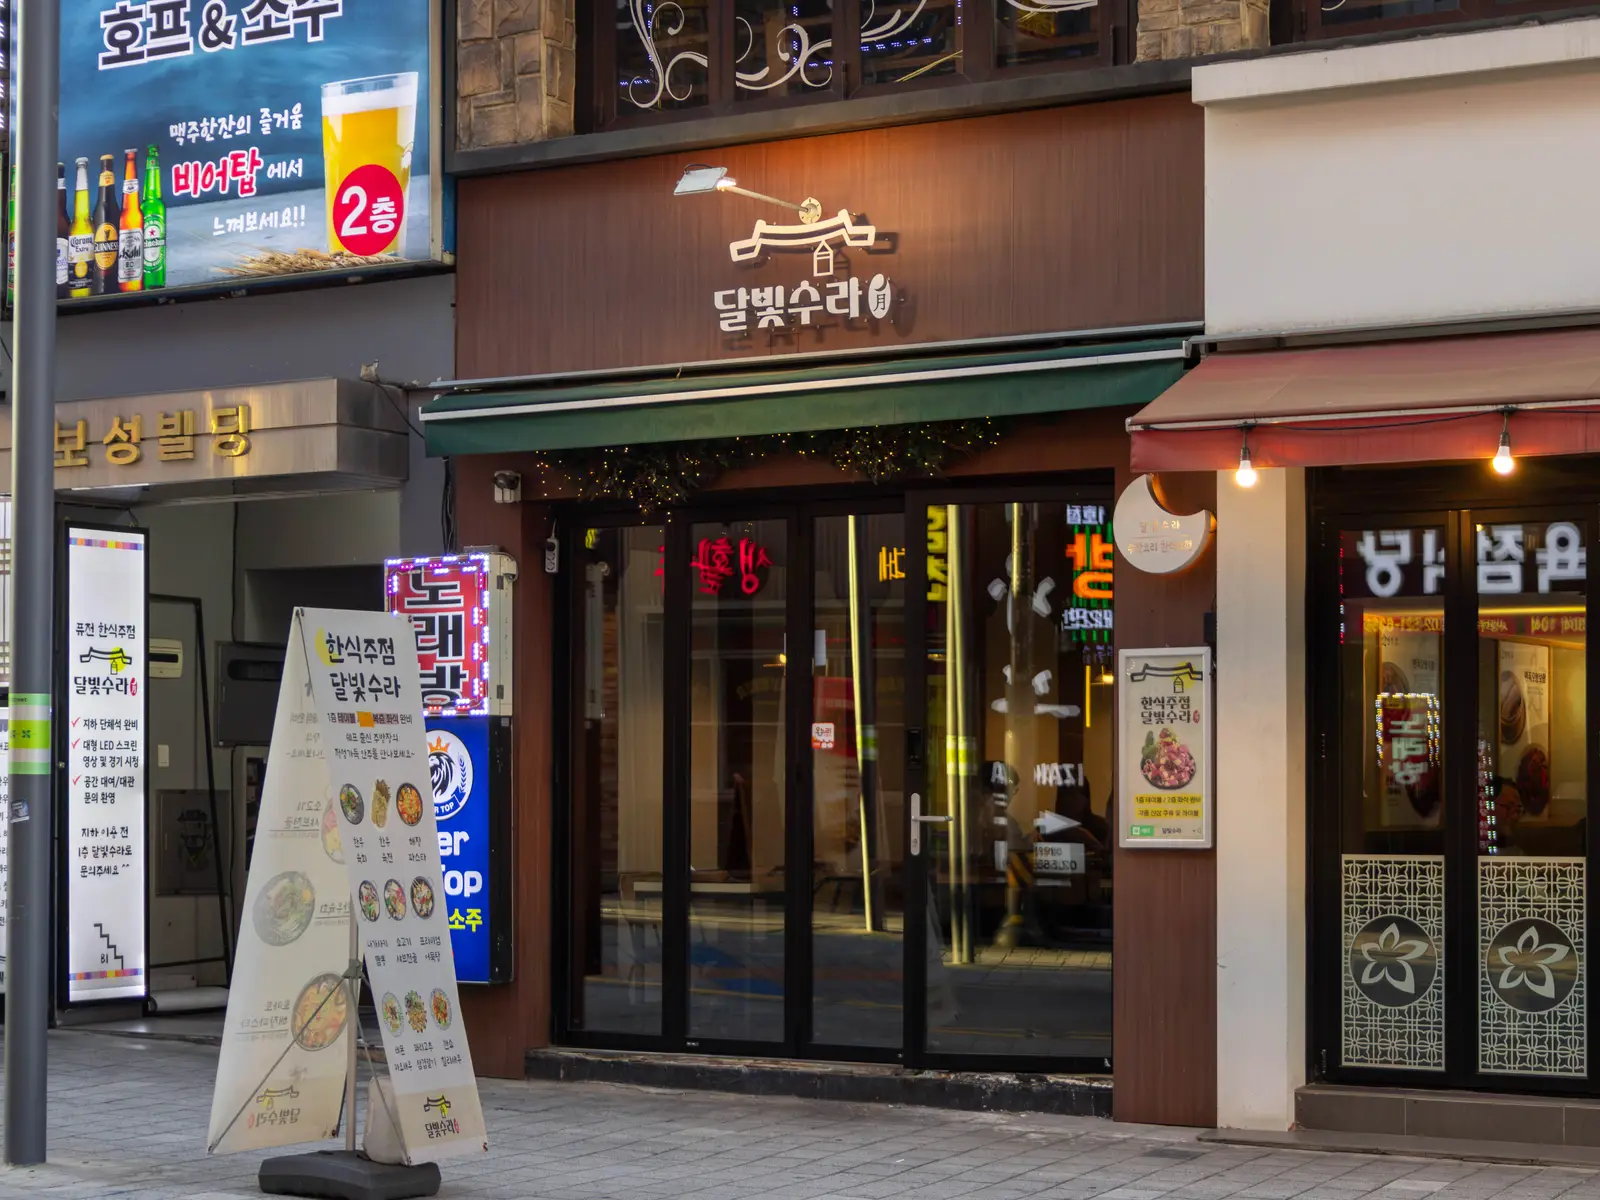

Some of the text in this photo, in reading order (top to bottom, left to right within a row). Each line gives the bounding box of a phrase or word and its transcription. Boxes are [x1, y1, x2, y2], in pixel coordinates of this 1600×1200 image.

[98, 0, 343, 70] 호프 & 소주
[169, 102, 303, 146] 맥주한잔의 즐거움
[172, 147, 303, 198] 비어탑 에서
[340, 185, 398, 237] 2층
[212, 205, 306, 236] 느껴보세요!!
[714, 277, 862, 332] 달빛수라
[54, 404, 250, 468] 보성빌딩
[75, 622, 136, 639] 퓨전 한식주점
[405, 566, 469, 708] 노래방
[326, 632, 395, 665] 한식주점
[74, 676, 129, 695] 달빛수라
[329, 672, 401, 702] 달빛수라
[1140, 695, 1190, 710] 한식주점
[83, 718, 138, 731] 지하 단체석 완비
[1140, 710, 1191, 725] 달빛수라
[83, 739, 137, 752] 대형 LED 스크린
[83, 756, 139, 768] 영상 및 경기 시청
[84, 776, 135, 788] 공간 대여/대관
[84, 792, 115, 804] 문의 환영
[81, 825, 129, 839] 지하 이용 전
[92, 845, 132, 859] 달빛수라로
[408, 852, 426, 862] 파스타
[80, 865, 119, 878] 문의주세요
[448, 908, 483, 932] 소주
[396, 937, 412, 947] 소고기
[425, 1119, 455, 1139] 달빛수라
